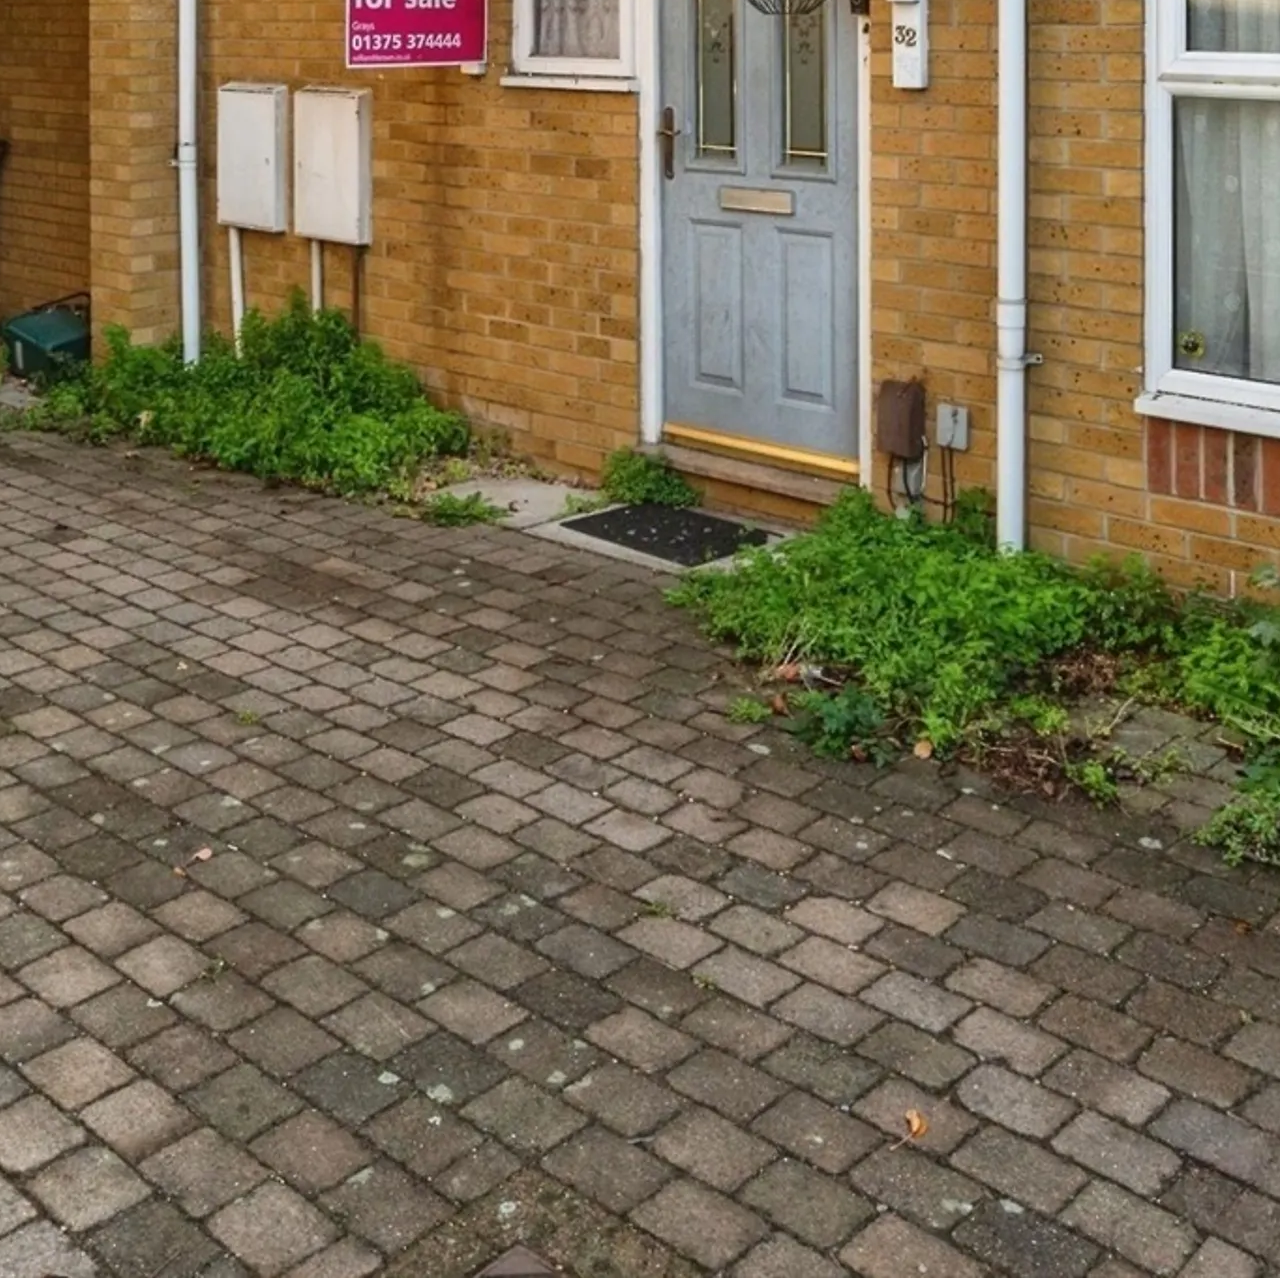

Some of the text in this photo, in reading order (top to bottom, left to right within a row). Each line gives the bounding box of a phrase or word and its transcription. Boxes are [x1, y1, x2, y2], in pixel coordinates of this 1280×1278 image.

[352, 32, 462, 51] 01375 374444
[895, 25, 917, 47] 32
